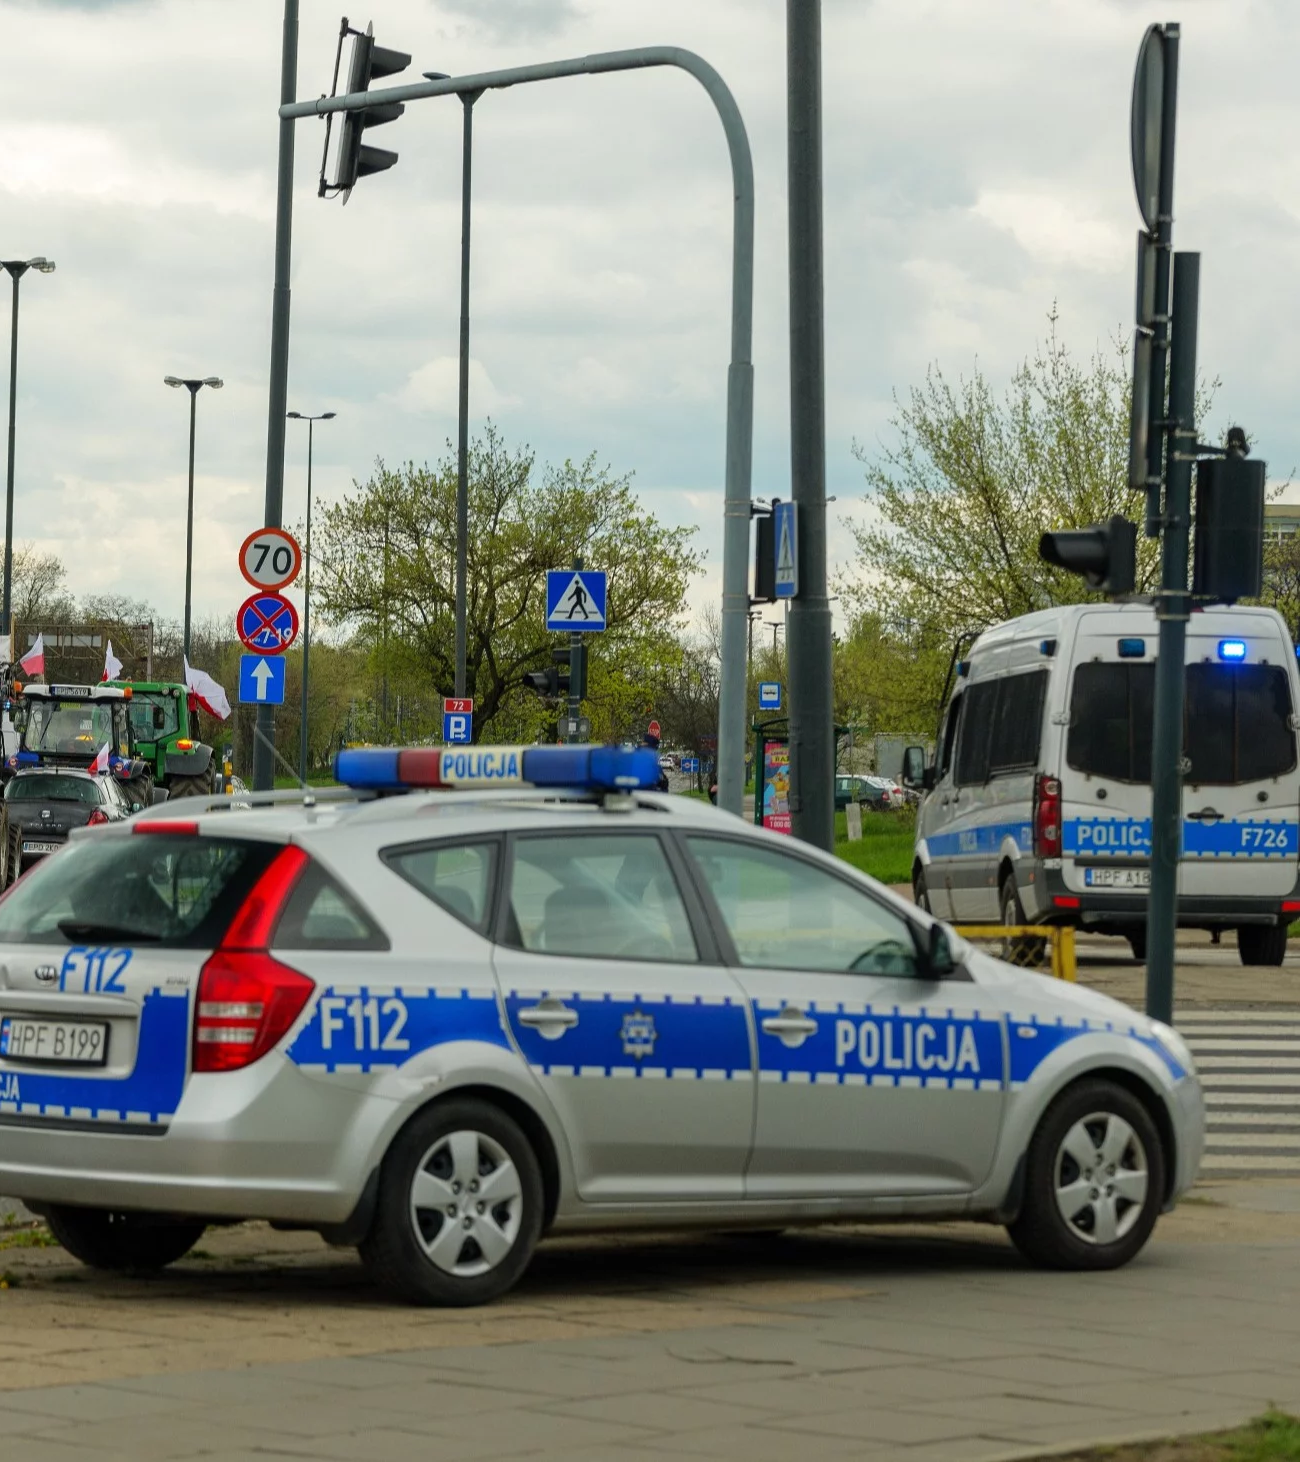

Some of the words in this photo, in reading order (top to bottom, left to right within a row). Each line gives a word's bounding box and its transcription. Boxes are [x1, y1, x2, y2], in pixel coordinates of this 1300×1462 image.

[253, 543, 292, 575] 70
[262, 627, 293, 644] 7-19
[453, 701, 464, 711] 72
[449, 716, 466, 739] P
[443, 753, 518, 778] POLICJA
[28, 843, 44, 851] EPD
[1241, 827, 1289, 847] F726
[1094, 869, 1121, 881] HPF
[60, 945, 133, 993] F112
[321, 998, 410, 1051] F112
[10, 1025, 47, 1054] HPF
[53, 1027, 100, 1059] B199
[835, 1019, 981, 1073] POLICJA
